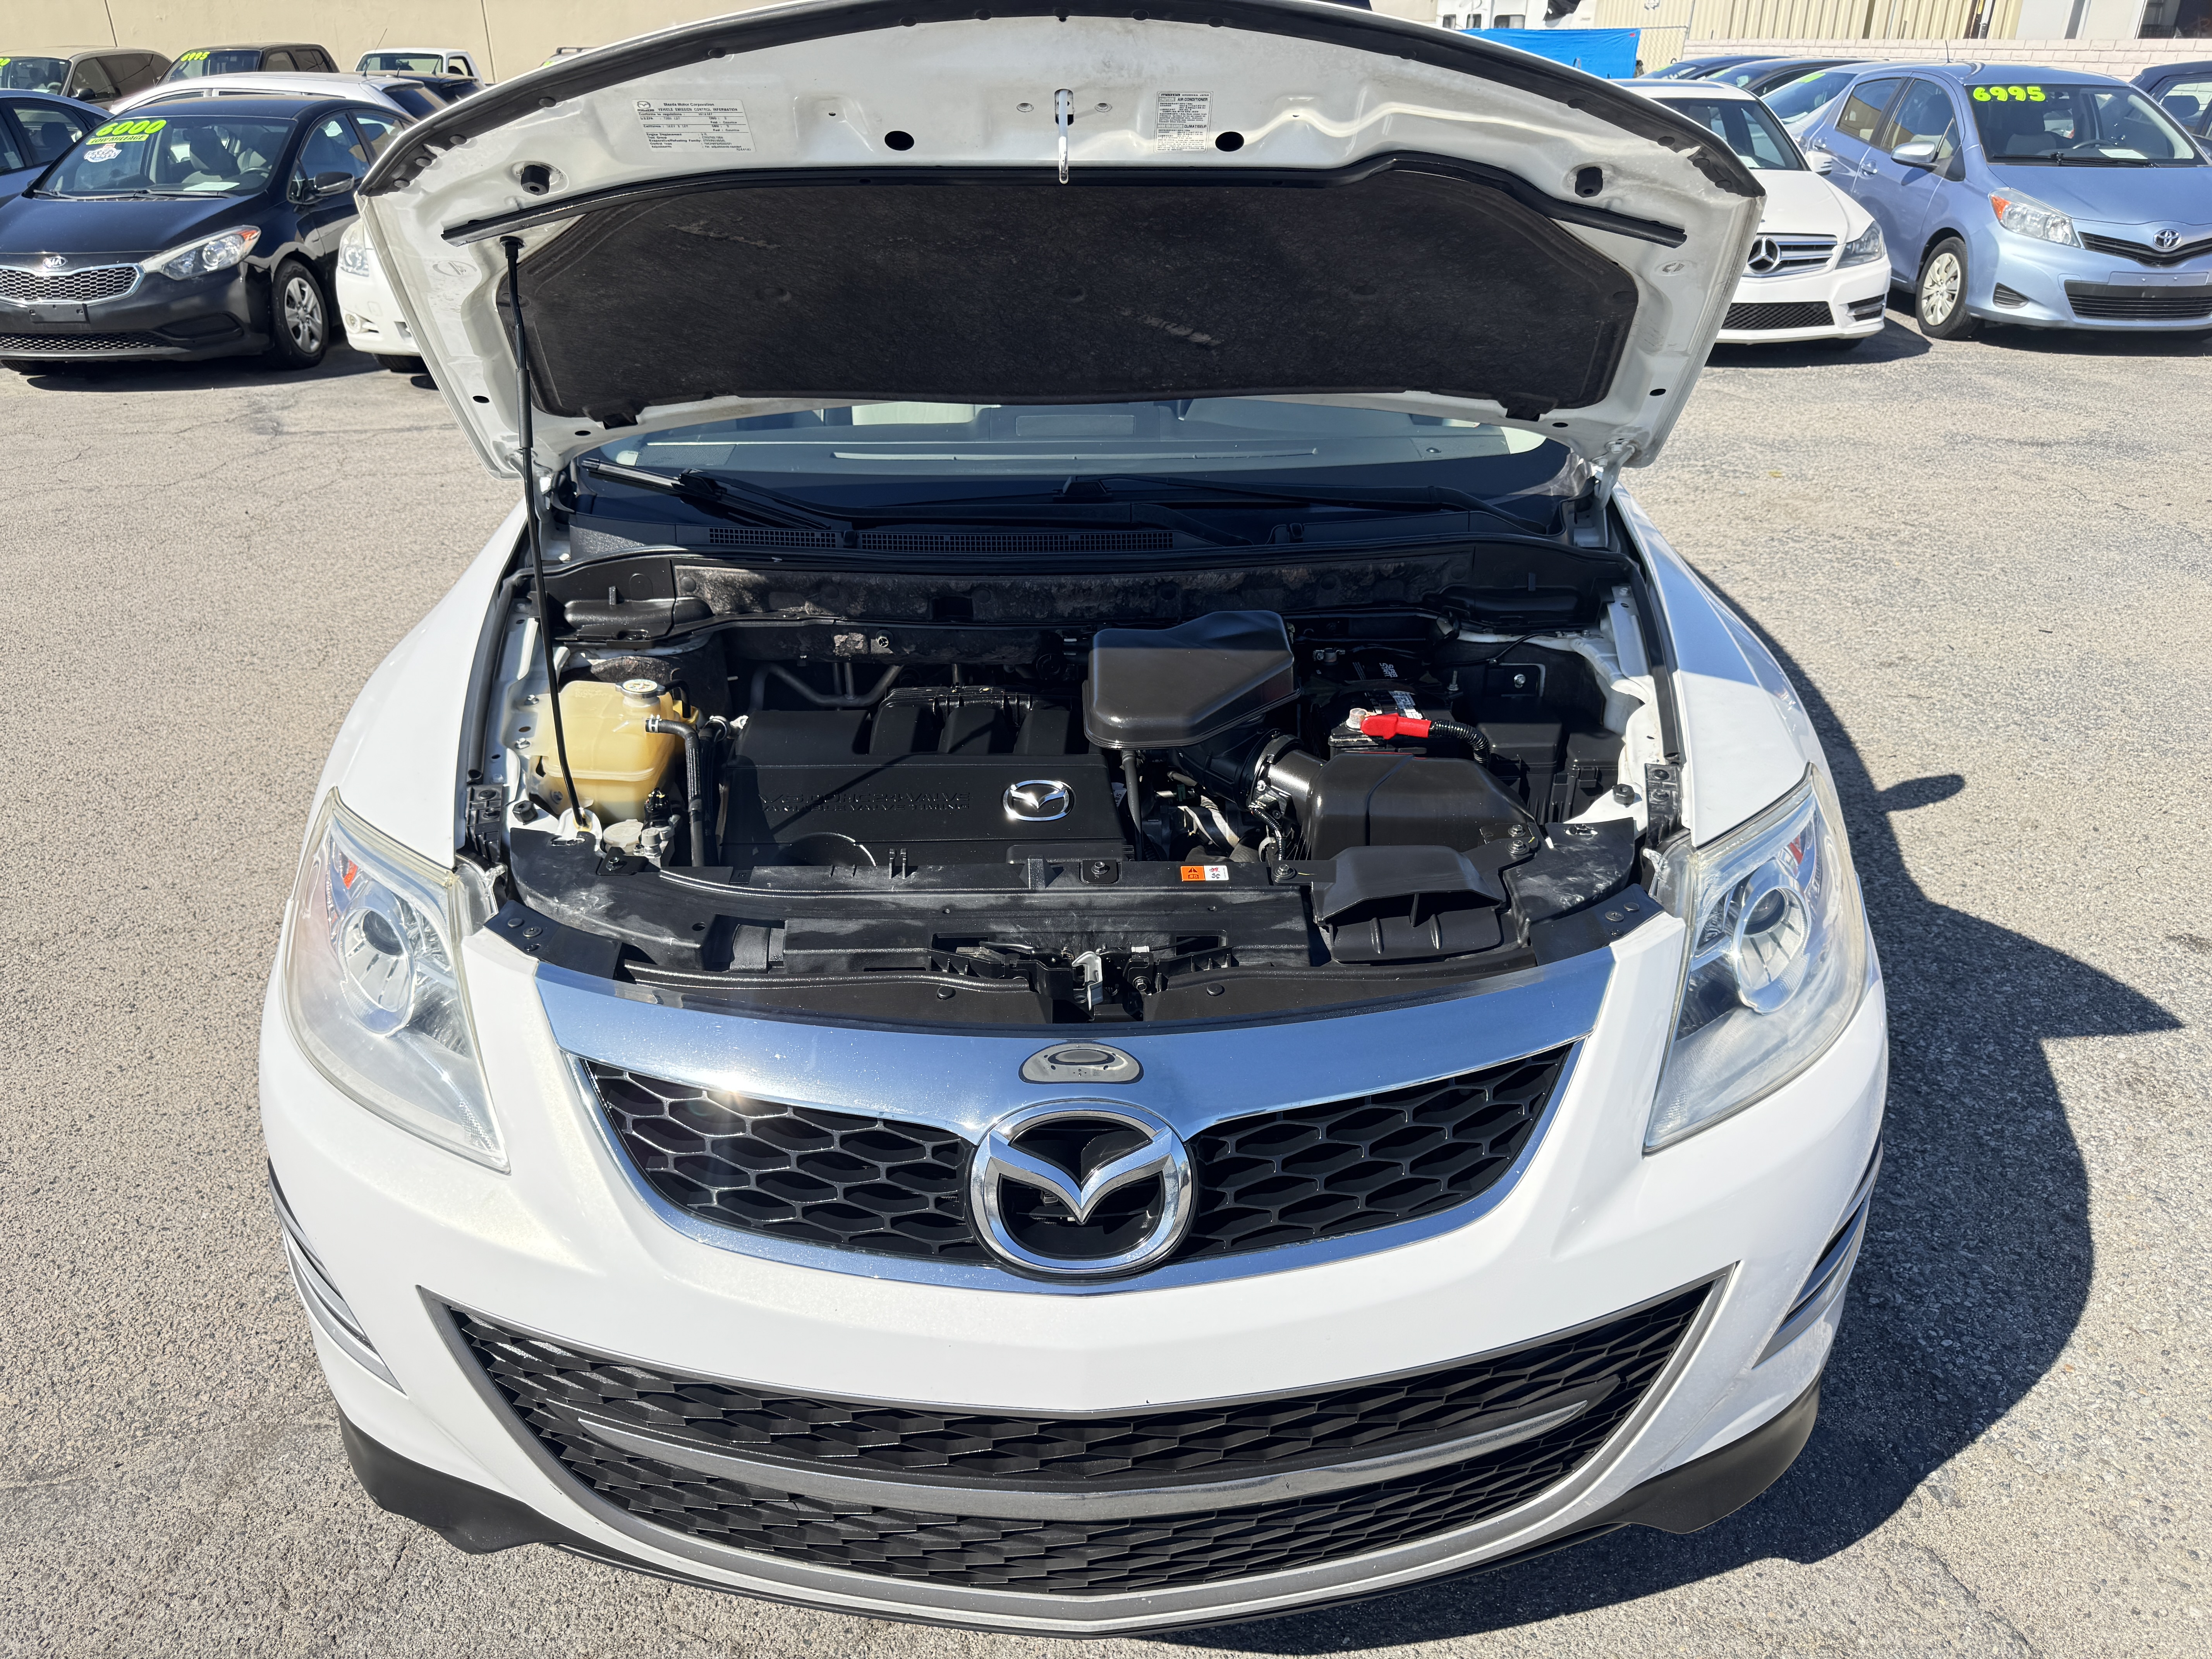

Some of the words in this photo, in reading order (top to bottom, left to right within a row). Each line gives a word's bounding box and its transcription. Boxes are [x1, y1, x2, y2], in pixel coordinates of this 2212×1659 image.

[180, 52, 210, 61] 6995
[1973, 86, 2045, 101] 6995
[96, 120, 167, 136] 6000
[806, 794, 871, 803] DOHC
